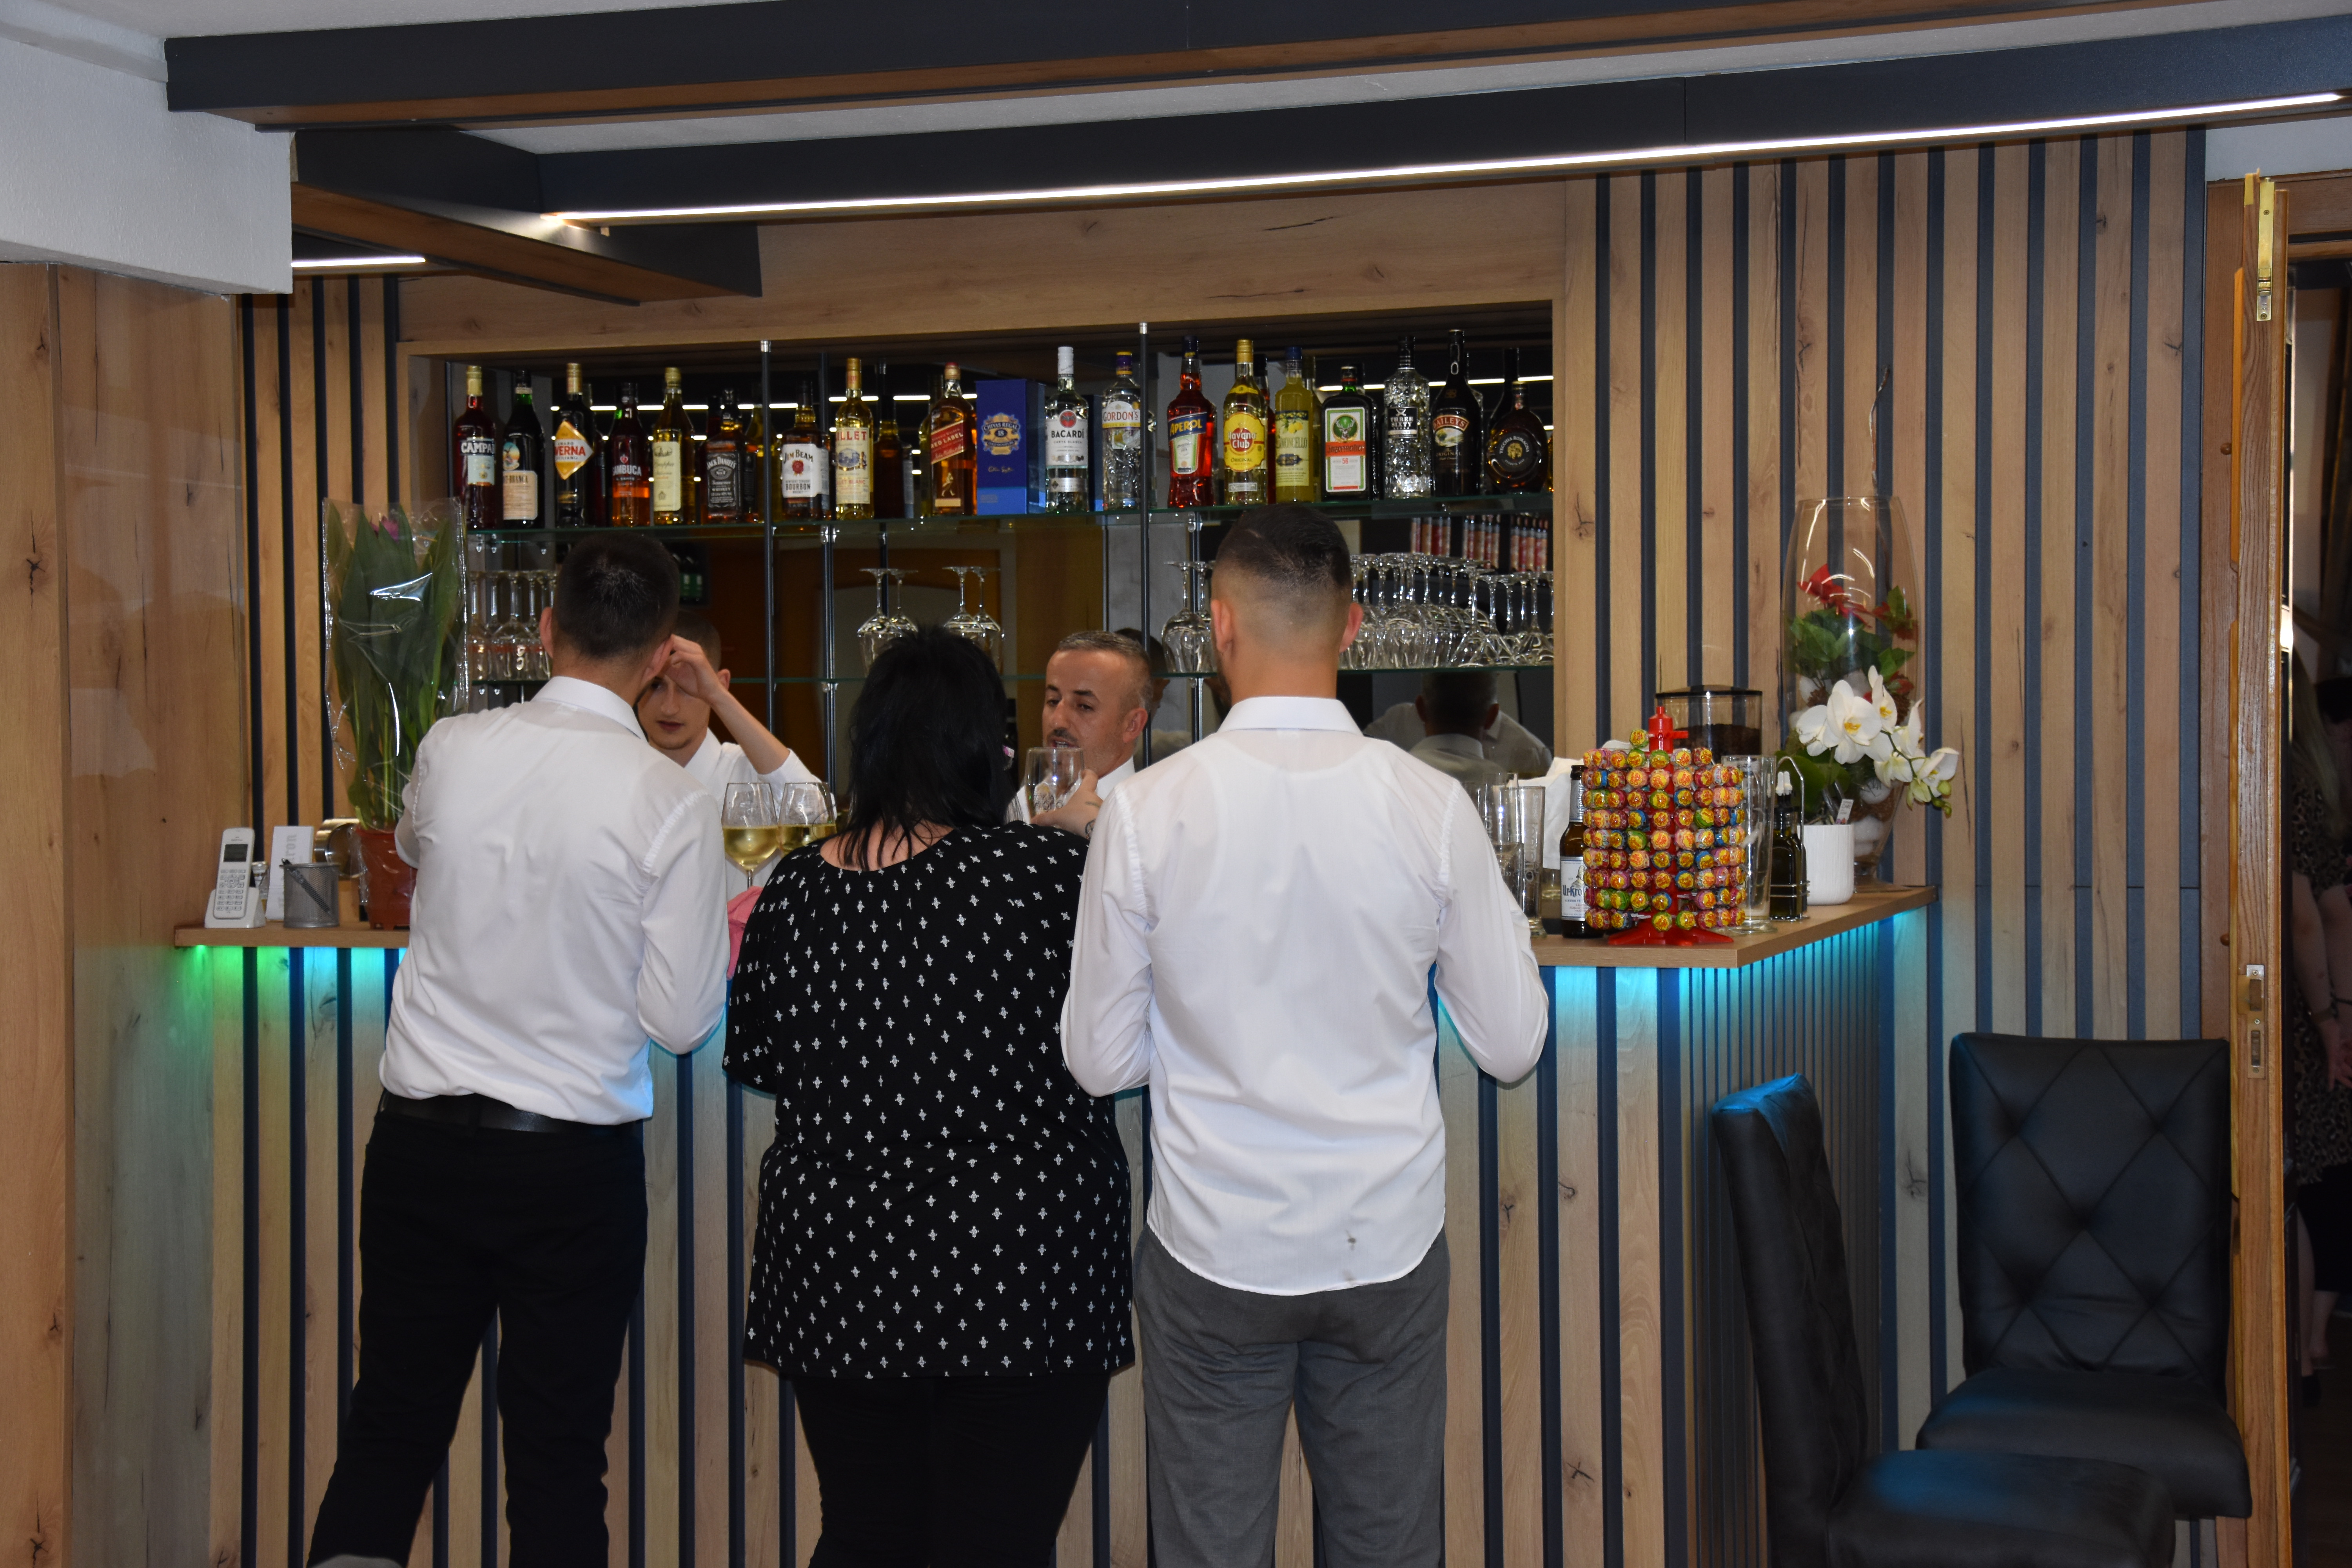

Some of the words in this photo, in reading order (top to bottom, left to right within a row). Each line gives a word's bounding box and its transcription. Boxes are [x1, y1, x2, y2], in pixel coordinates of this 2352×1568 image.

[1103, 411, 1138, 421] GORDON'S
[984, 423, 1001, 431] CHIVAS
[1170, 419, 1203, 436] APEROL
[931, 440, 942, 449] RED
[943, 432, 964, 443] LABEL
[1232, 439, 1250, 448] Club
[1513, 436, 1530, 453] ROMAGNA
[707, 459, 718, 470] JACK
[717, 457, 736, 470] DANIEL'S
[783, 452, 794, 464] JIM
[795, 450, 813, 462] BEAM
